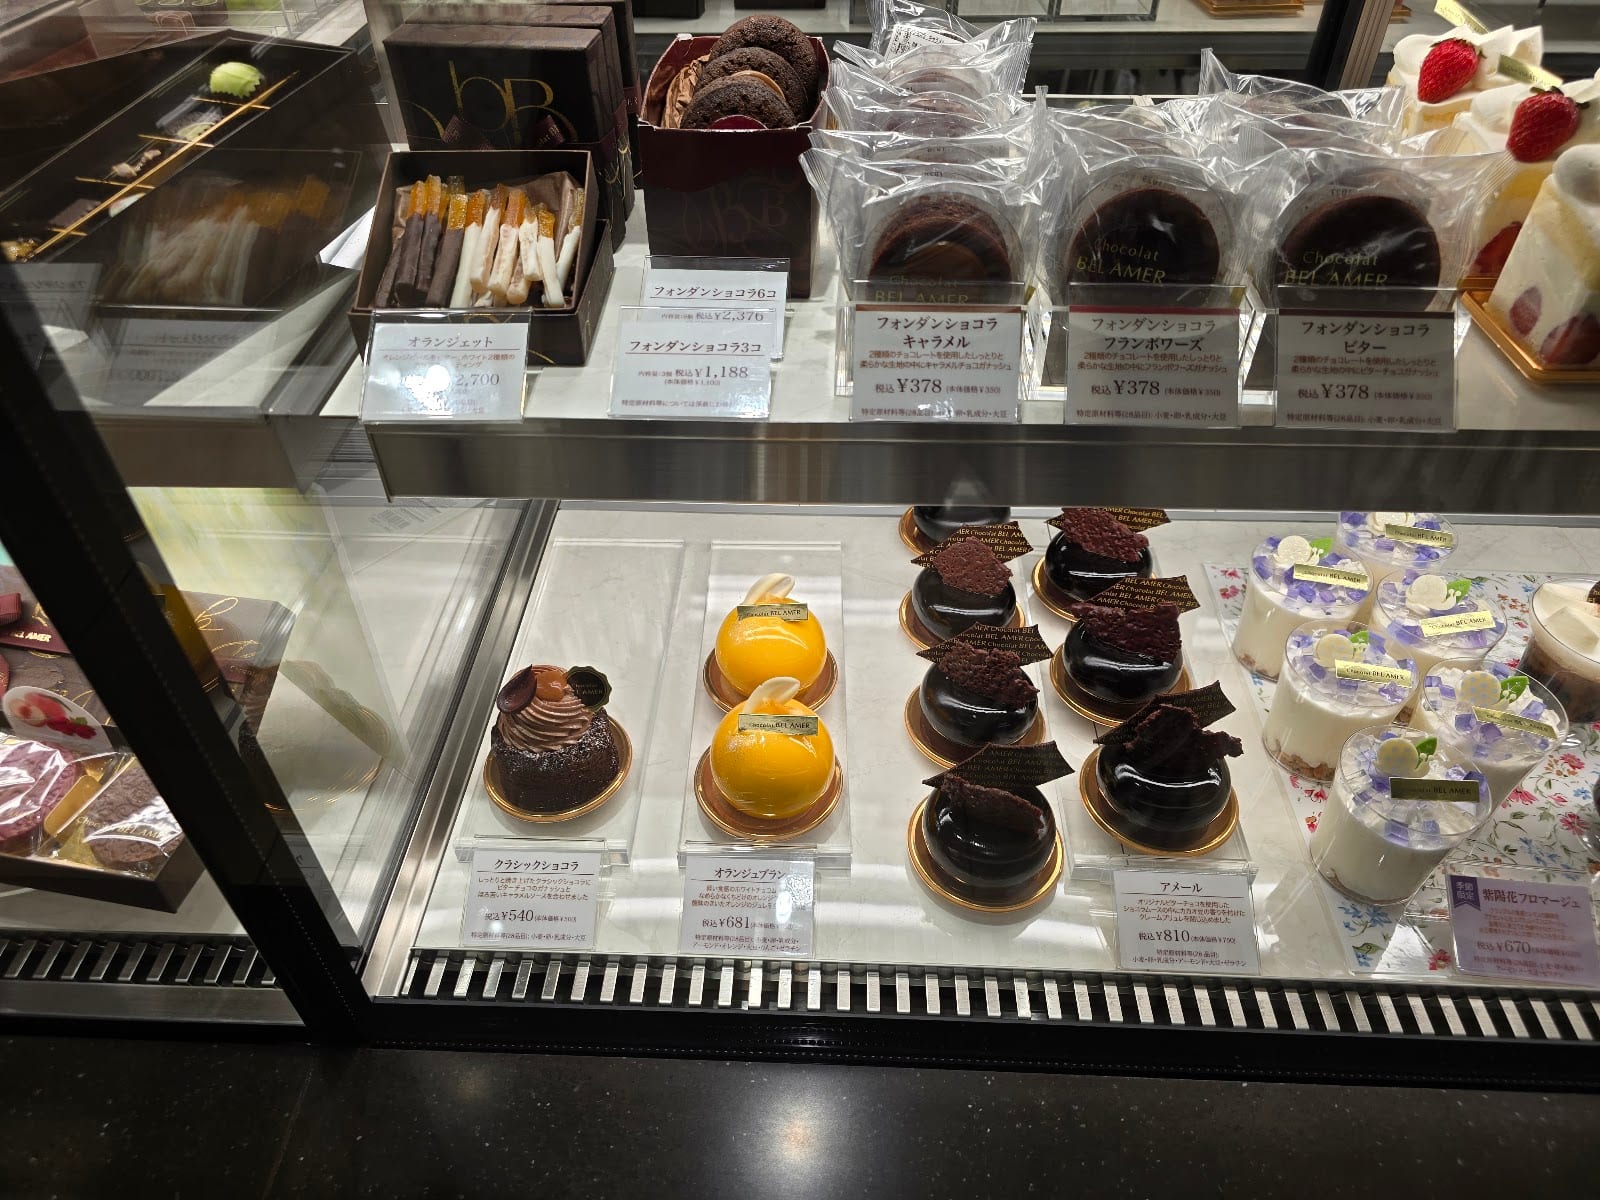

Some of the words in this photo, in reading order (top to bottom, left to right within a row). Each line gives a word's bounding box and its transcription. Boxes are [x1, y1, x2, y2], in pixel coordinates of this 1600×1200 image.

[1094, 238, 1159, 262] Chocolat
[1302, 251, 1378, 266] Chocolat
[1076, 256, 1104, 274] BEL
[1110, 261, 1166, 284] AMER
[1284, 270, 1317, 286] BEL
[1328, 272, 1388, 286] AMER
[654, 286, 777, 299] フォンダンショコラ6コ
[877, 316, 998, 331] フォンダンショコラ
[1092, 316, 1216, 334] フォンダンショコラ
[1302, 320, 1430, 337] フォンダンショコラ
[408, 336, 493, 348] オランジェット
[630, 340, 762, 354] フォンダンショコラ3コ
[903, 334, 970, 349] キャラメル
[1104, 337, 1204, 351] フランボワーズ
[1344, 340, 1387, 354] ビター
[1434, 786, 1448, 794] BEL
[1450, 787, 1471, 795] AMER
[494, 858, 580, 872] クラシックショコラ
[714, 867, 786, 880] オランジュブラン
[1160, 882, 1202, 893] アメール
[1482, 888, 1581, 908] 紫陽花フロマージュ
